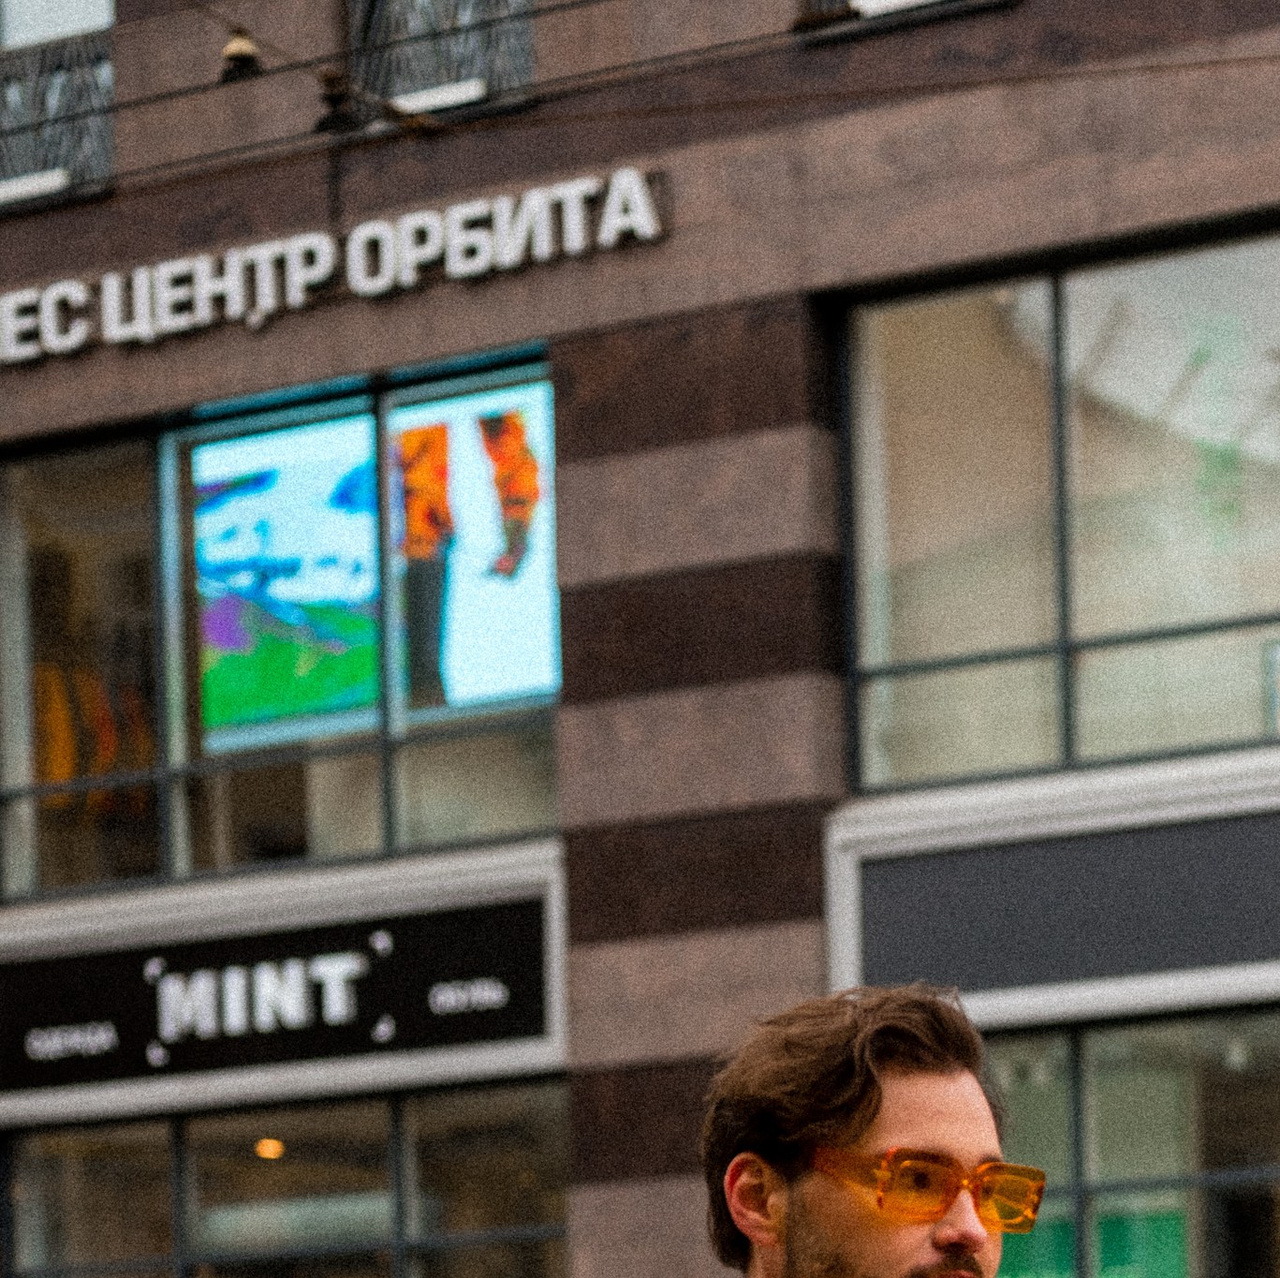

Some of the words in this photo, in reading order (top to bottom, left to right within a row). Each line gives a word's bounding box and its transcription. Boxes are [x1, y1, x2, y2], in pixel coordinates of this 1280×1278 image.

[0, 279, 89, 361] ЕС
[101, 231, 336, 343] ЦЕНТР
[346, 166, 661, 295] ОРБИТА
[157, 952, 366, 1042] MINT
